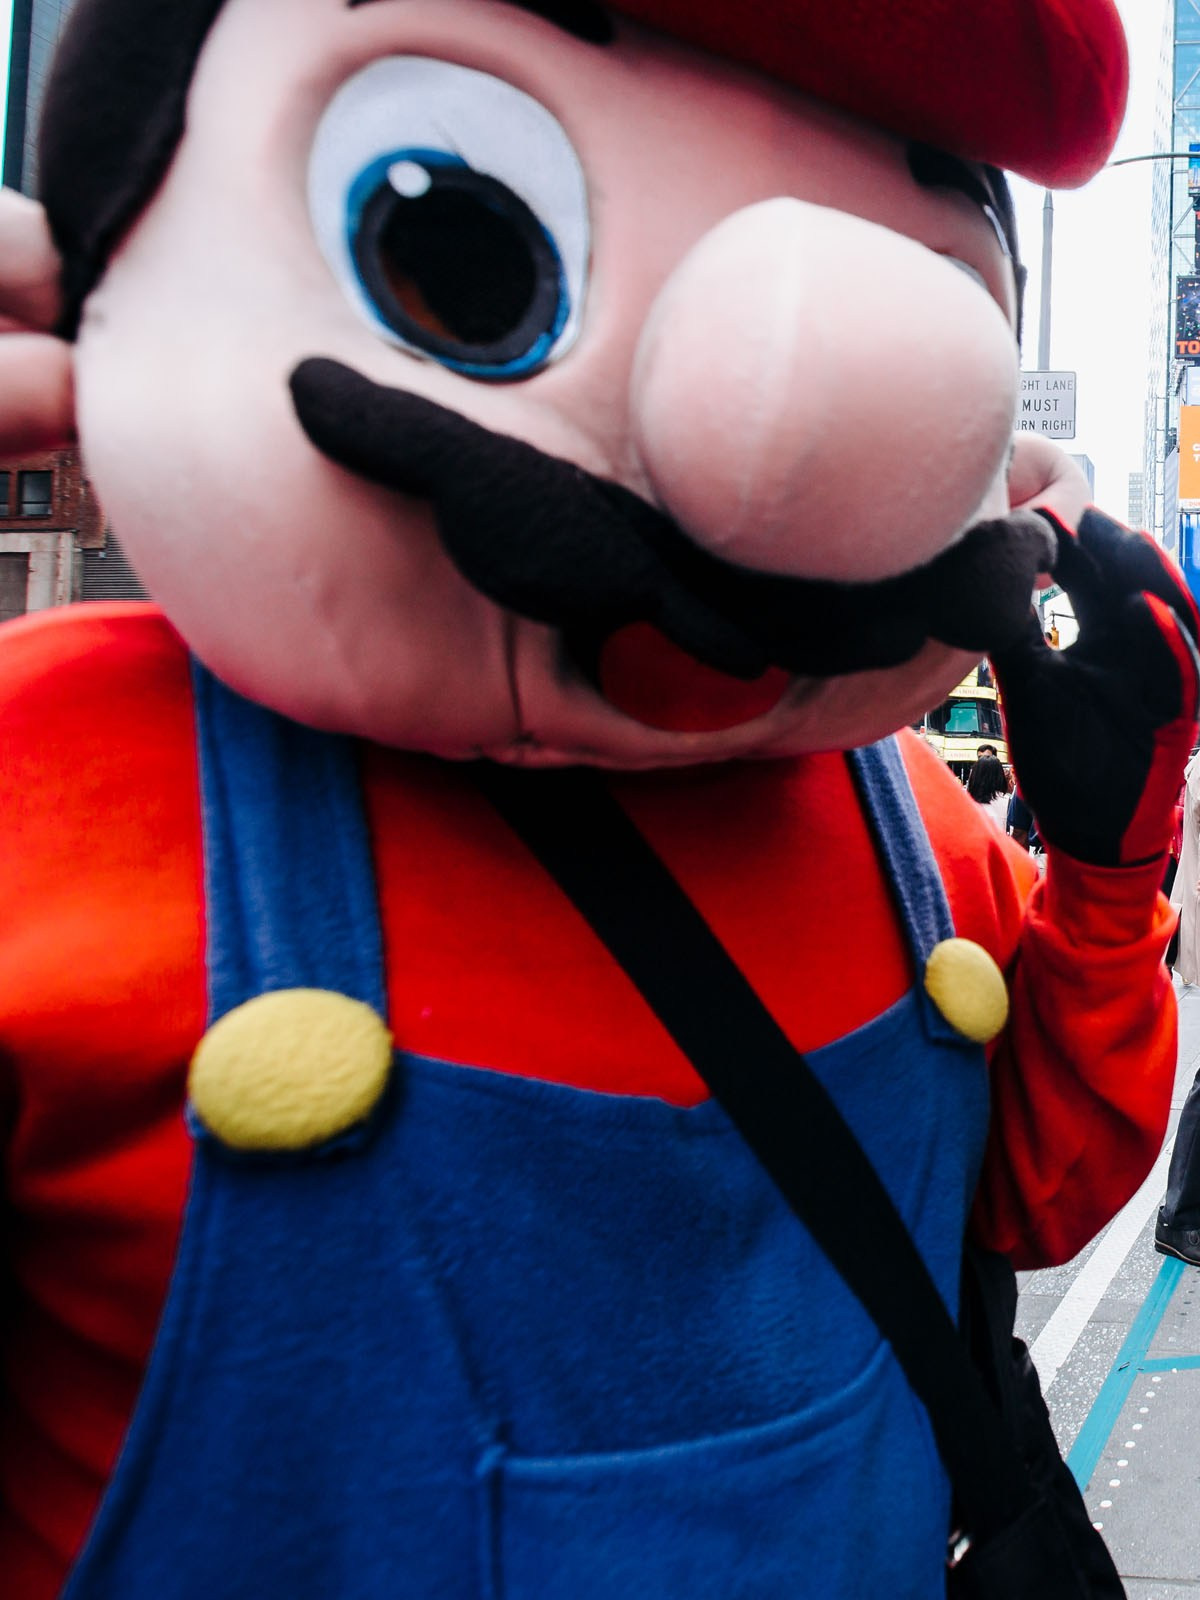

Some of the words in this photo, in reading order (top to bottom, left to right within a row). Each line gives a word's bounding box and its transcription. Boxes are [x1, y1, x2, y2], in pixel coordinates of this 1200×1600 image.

[1021, 379, 1040, 390] GHT
[1046, 380, 1073, 390] LANE
[1022, 399, 1059, 411] MUST
[1014, 420, 1035, 430] URN
[1041, 420, 1073, 430] RIGHT
